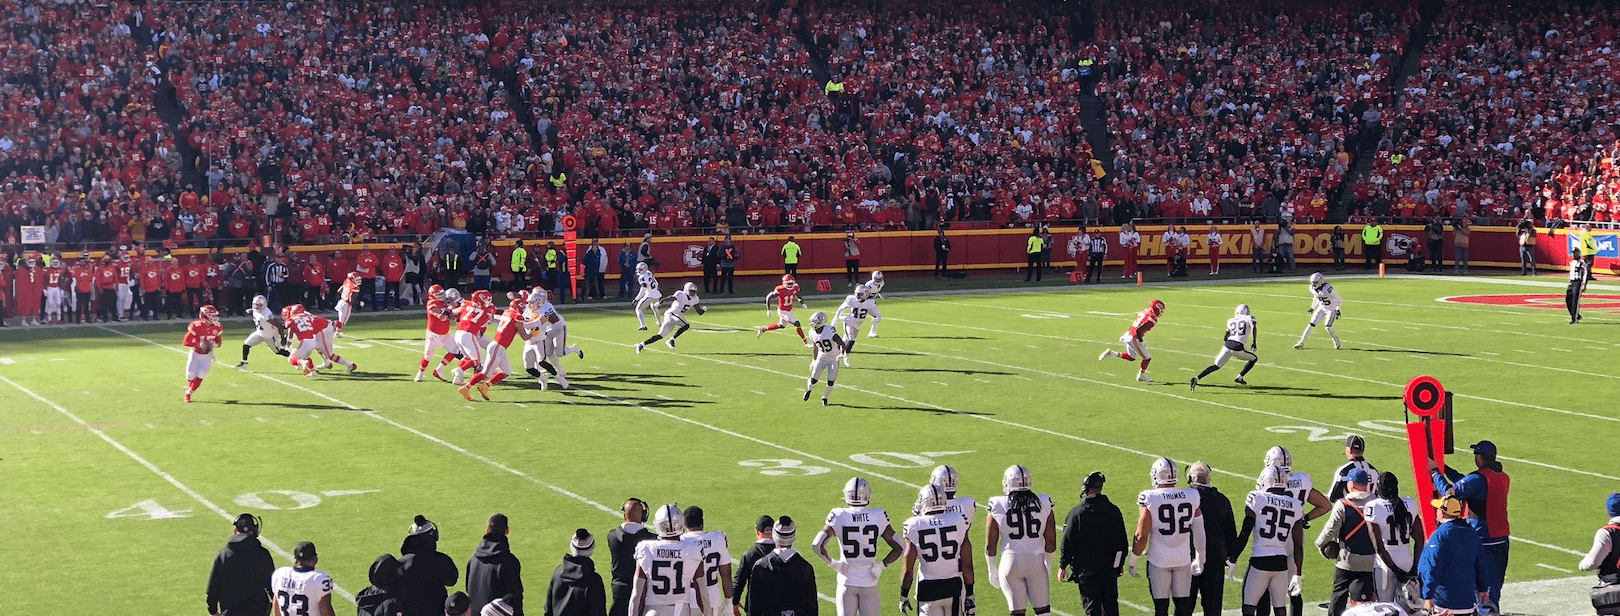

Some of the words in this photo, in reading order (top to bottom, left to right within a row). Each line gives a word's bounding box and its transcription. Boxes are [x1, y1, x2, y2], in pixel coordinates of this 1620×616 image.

[462, 305, 484, 323] 77
[852, 307, 868, 320] 42
[1162, 491, 1186, 500] THOMAS
[852, 512, 871, 523] WHITE
[929, 518, 943, 526] LEE
[1006, 506, 1041, 540] 96
[1158, 502, 1193, 536] 92
[1260, 505, 1295, 542] 35
[656, 548, 683, 559] KOONCE
[842, 524, 879, 558] 53
[918, 525, 958, 562] 55
[651, 560, 686, 595] 51
